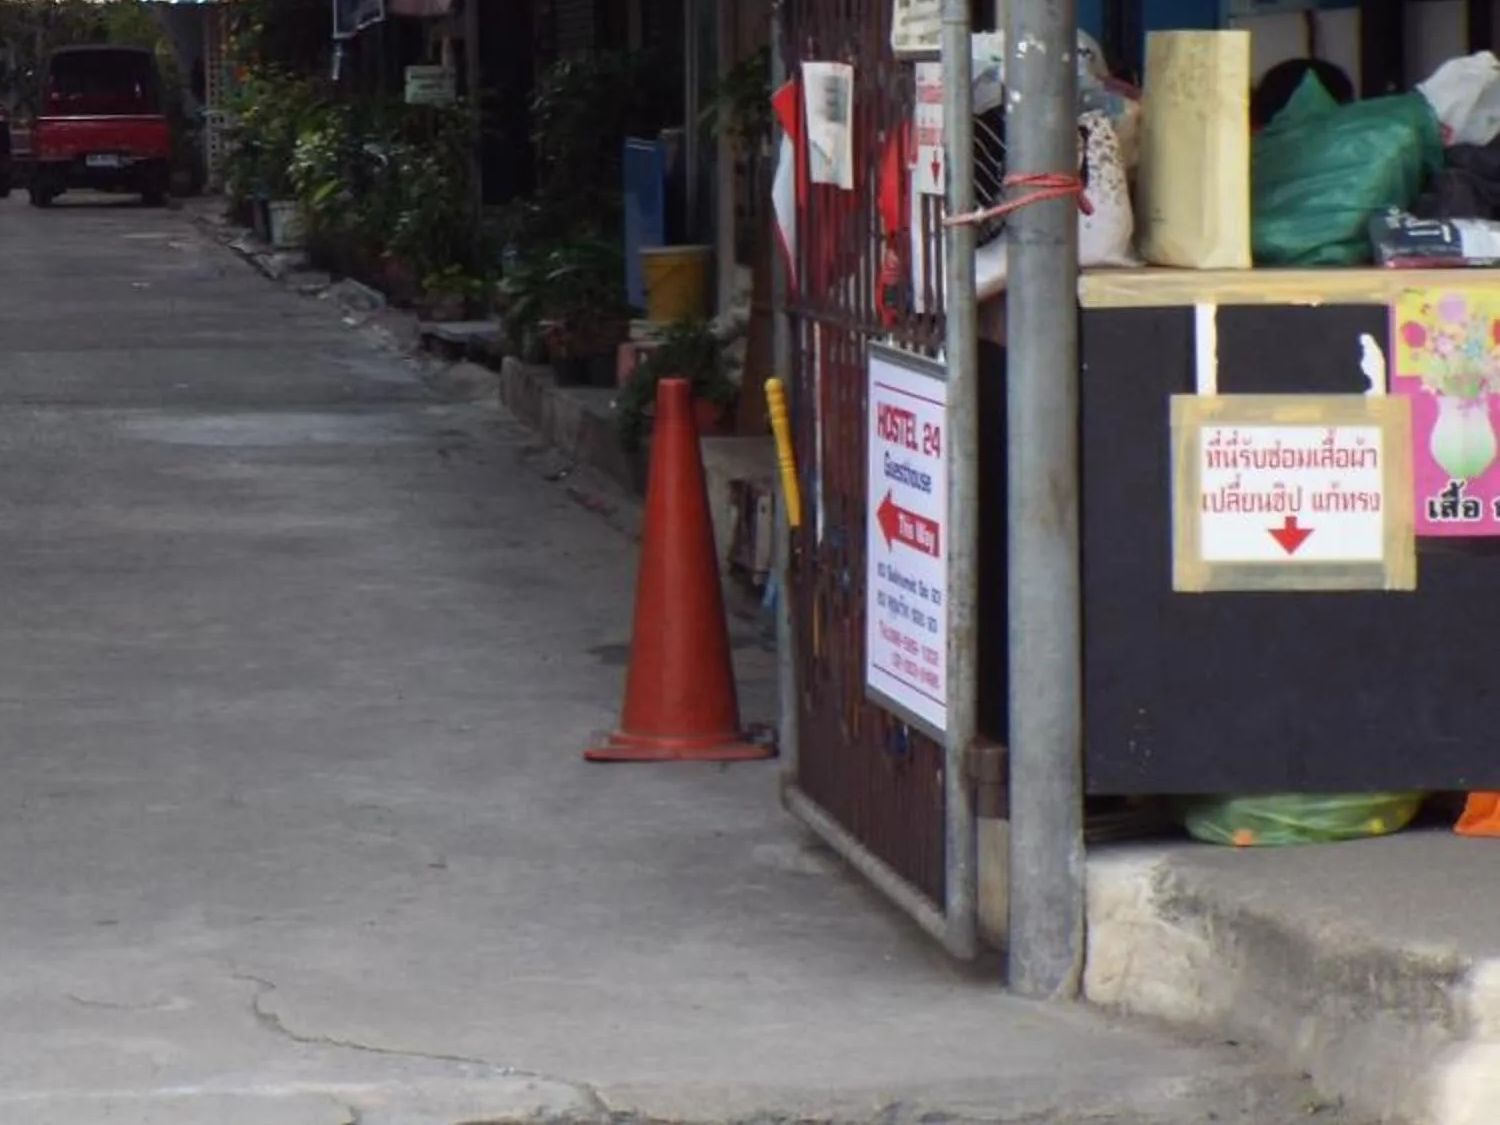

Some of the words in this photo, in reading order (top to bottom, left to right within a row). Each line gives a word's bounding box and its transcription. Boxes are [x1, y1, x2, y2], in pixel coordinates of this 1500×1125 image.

[877, 401, 919, 452] HOSTEL
[923, 421, 941, 459] 24
[1428, 479, 1480, 519] เสื้อ
